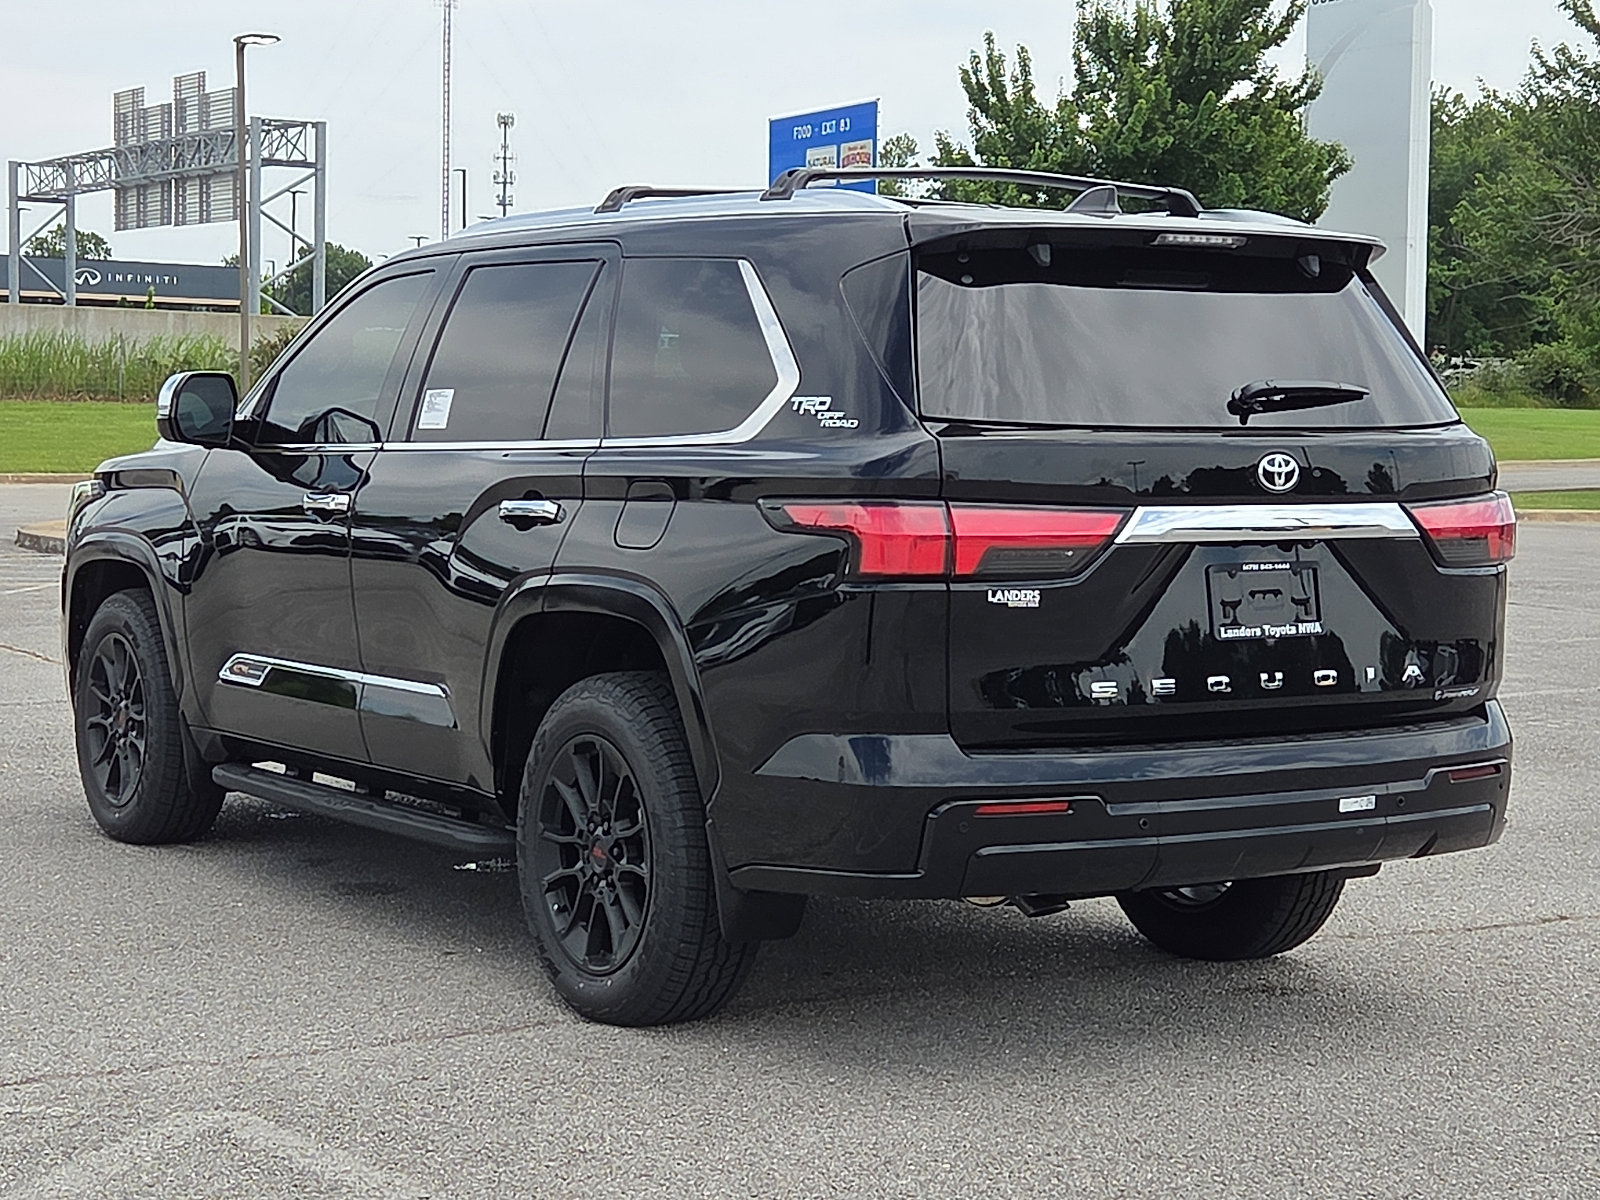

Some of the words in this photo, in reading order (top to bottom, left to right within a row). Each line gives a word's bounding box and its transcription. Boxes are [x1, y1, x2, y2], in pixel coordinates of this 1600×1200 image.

[793, 124, 812, 139] FOOD
[107, 273, 178, 284] INFINITI
[791, 396, 832, 414] TRD
[817, 411, 846, 420] OFF
[820, 419, 859, 428] ROAD
[987, 589, 1041, 603] LANDERS
[1220, 626, 1262, 638] Landers
[1262, 624, 1297, 638] Toyota
[1298, 622, 1322, 633] NWA
[1091, 664, 1425, 698] SEQUOIA
